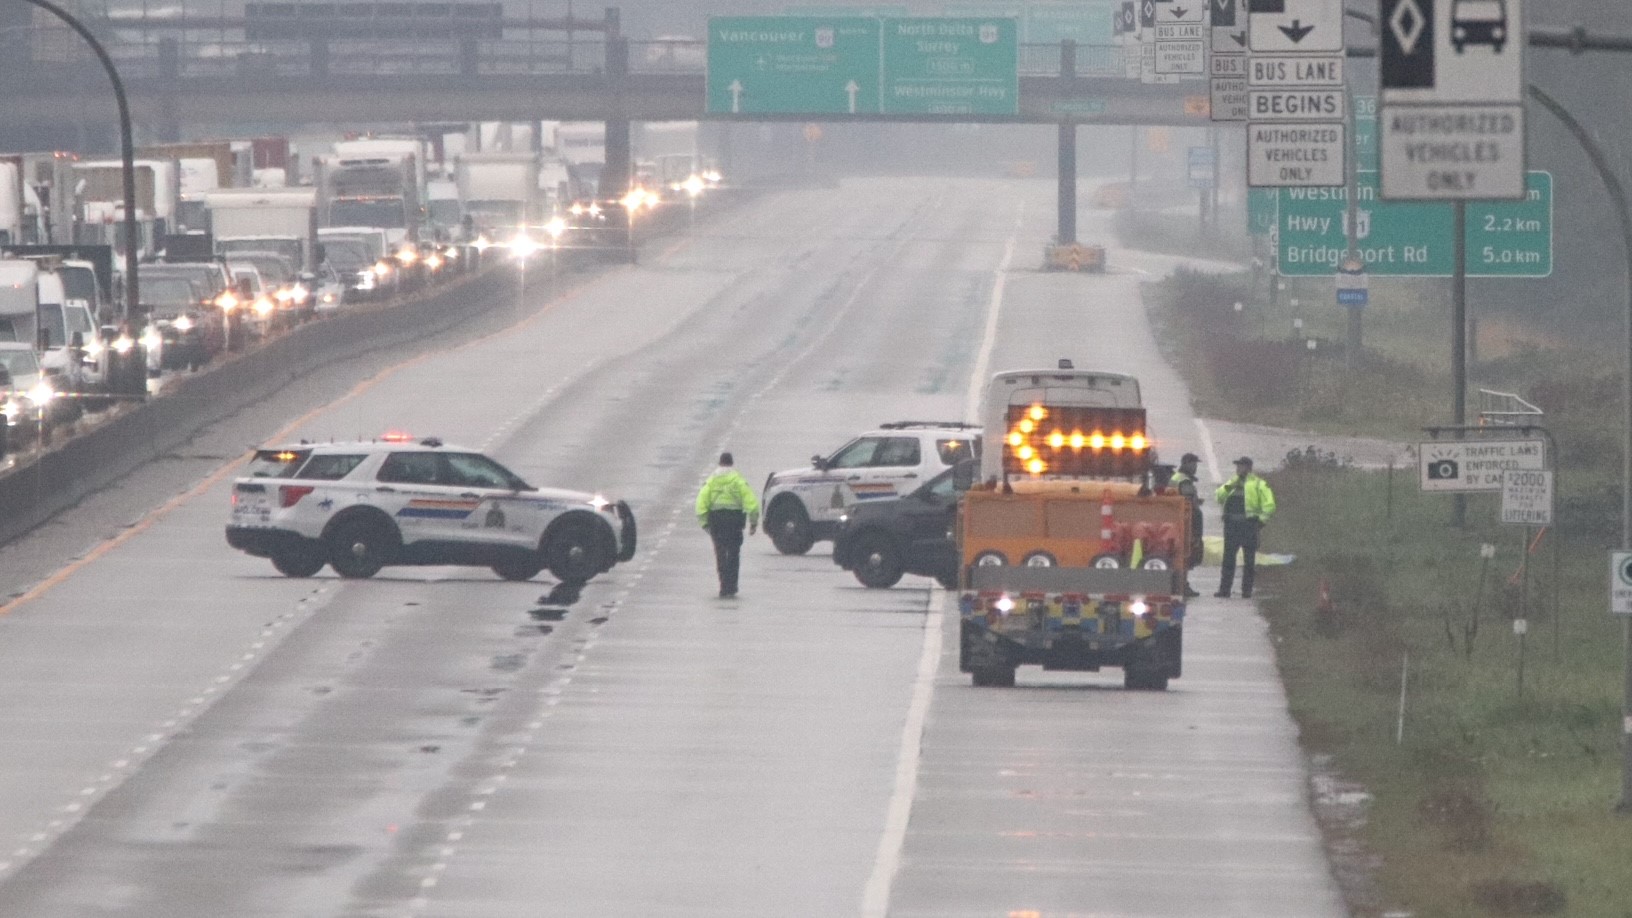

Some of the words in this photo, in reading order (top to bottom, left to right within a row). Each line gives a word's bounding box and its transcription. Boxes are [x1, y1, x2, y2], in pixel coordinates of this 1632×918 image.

[719, 30, 805, 42] Vancouver
[898, 24, 935, 35] North
[1158, 26, 1175, 37] BUS
[1179, 26, 1200, 37] LANE
[1159, 43, 1200, 52] AUTHORIZED
[1164, 53, 1195, 61] VEHICLES
[1216, 59, 1237, 72] BUS
[1255, 62, 1286, 80] BUS
[1296, 62, 1336, 80] LANE
[1215, 82, 1244, 91] AUTHO
[1256, 95, 1336, 113] BEGINS
[1391, 113, 1514, 134] AUTHORIZED
[1256, 129, 1337, 143] AUTHORIZED
[1265, 149, 1328, 162] VEHICLES
[1405, 142, 1500, 162] VEHICLES
[1279, 167, 1313, 181] ONLY
[1427, 170, 1476, 190] ONLY
[1288, 215, 1331, 235] Hwy
[1484, 215, 1513, 232] 2.2
[1516, 217, 1540, 232] km
[1288, 245, 1395, 267] Bridgeort
[1404, 246, 1428, 263] Rd
[1483, 246, 1513, 263] 5.0
[1516, 248, 1540, 263] km
[1465, 447, 1505, 457] TRAFFIC
[1511, 446, 1538, 456] LAWS
[1466, 460, 1519, 470] ENFORCED
[1466, 474, 1479, 484] BY
